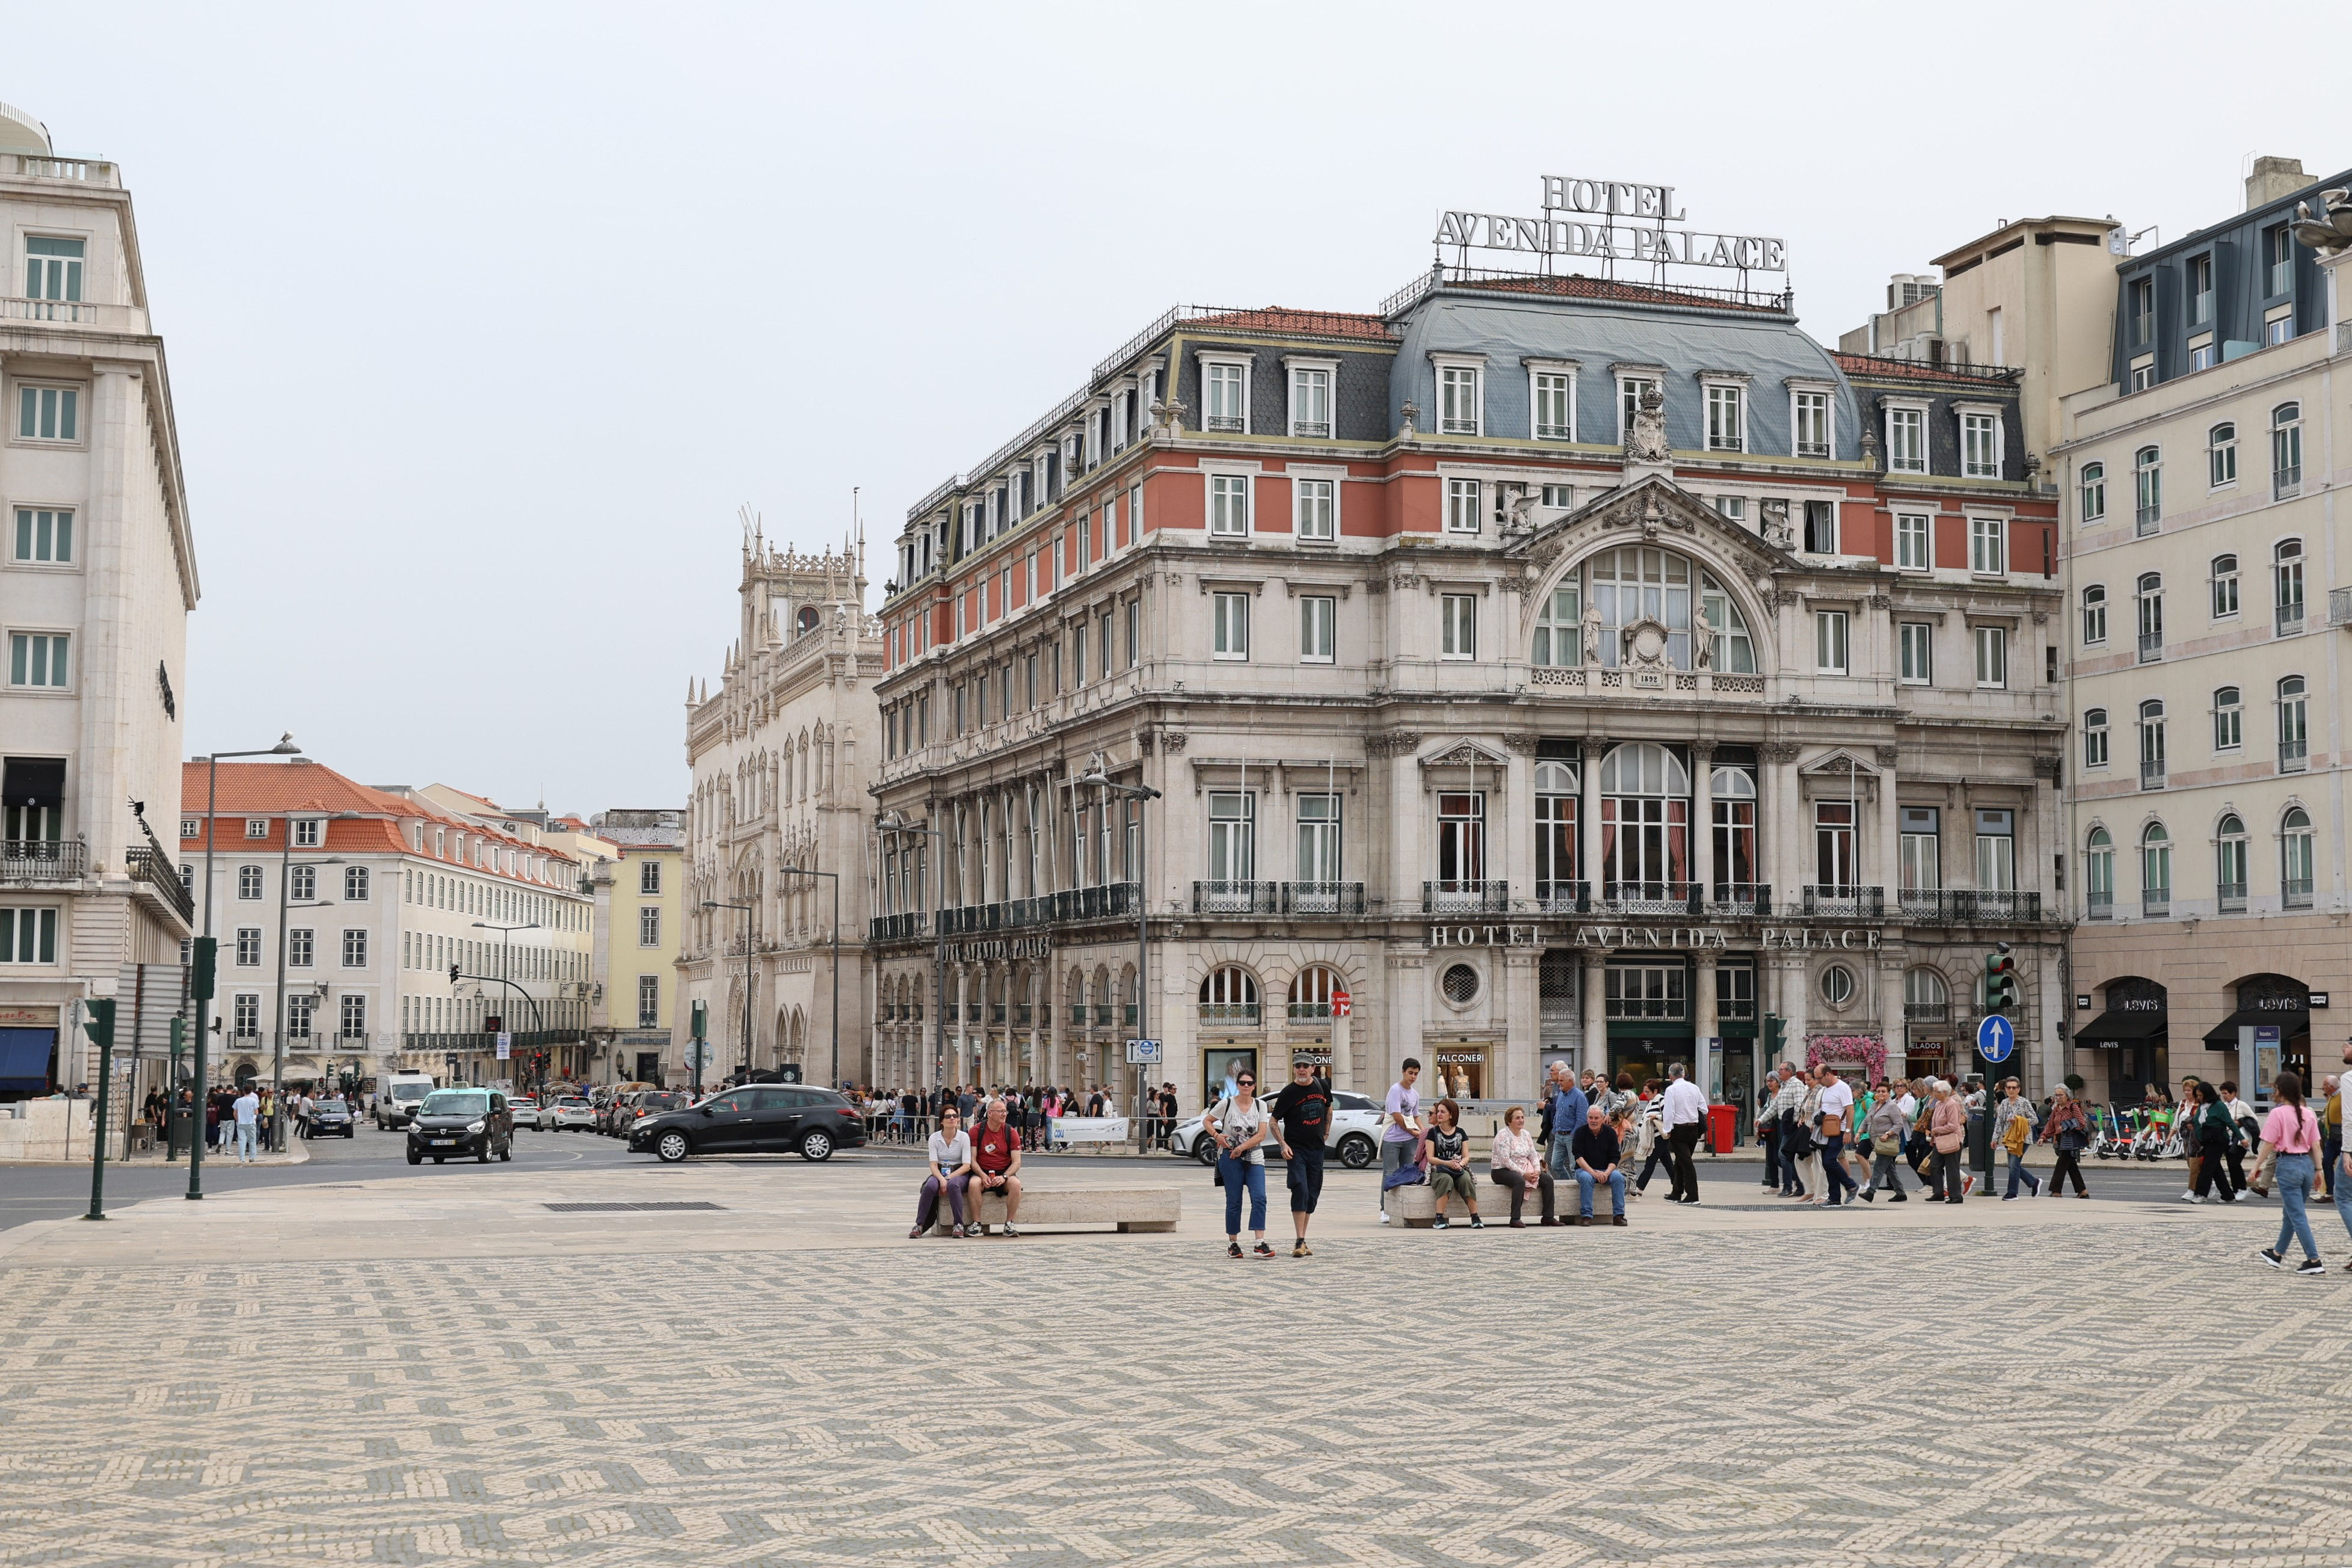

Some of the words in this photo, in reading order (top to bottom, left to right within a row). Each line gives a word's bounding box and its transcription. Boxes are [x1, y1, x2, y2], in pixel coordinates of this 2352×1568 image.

[1541, 176, 1685, 220] HOTEL
[1433, 212, 1619, 257] AVENIDA
[1632, 227, 1785, 271] PALACE
[1430, 925, 1547, 947] HOTEL
[1572, 926, 1727, 948] AVENIDA
[1759, 928, 1881, 950] PALACE
[1437, 1054, 1485, 1062] FALCONERI
[1821, 1053, 1835, 1063] NE
[1839, 1052, 1866, 1063] MORE
